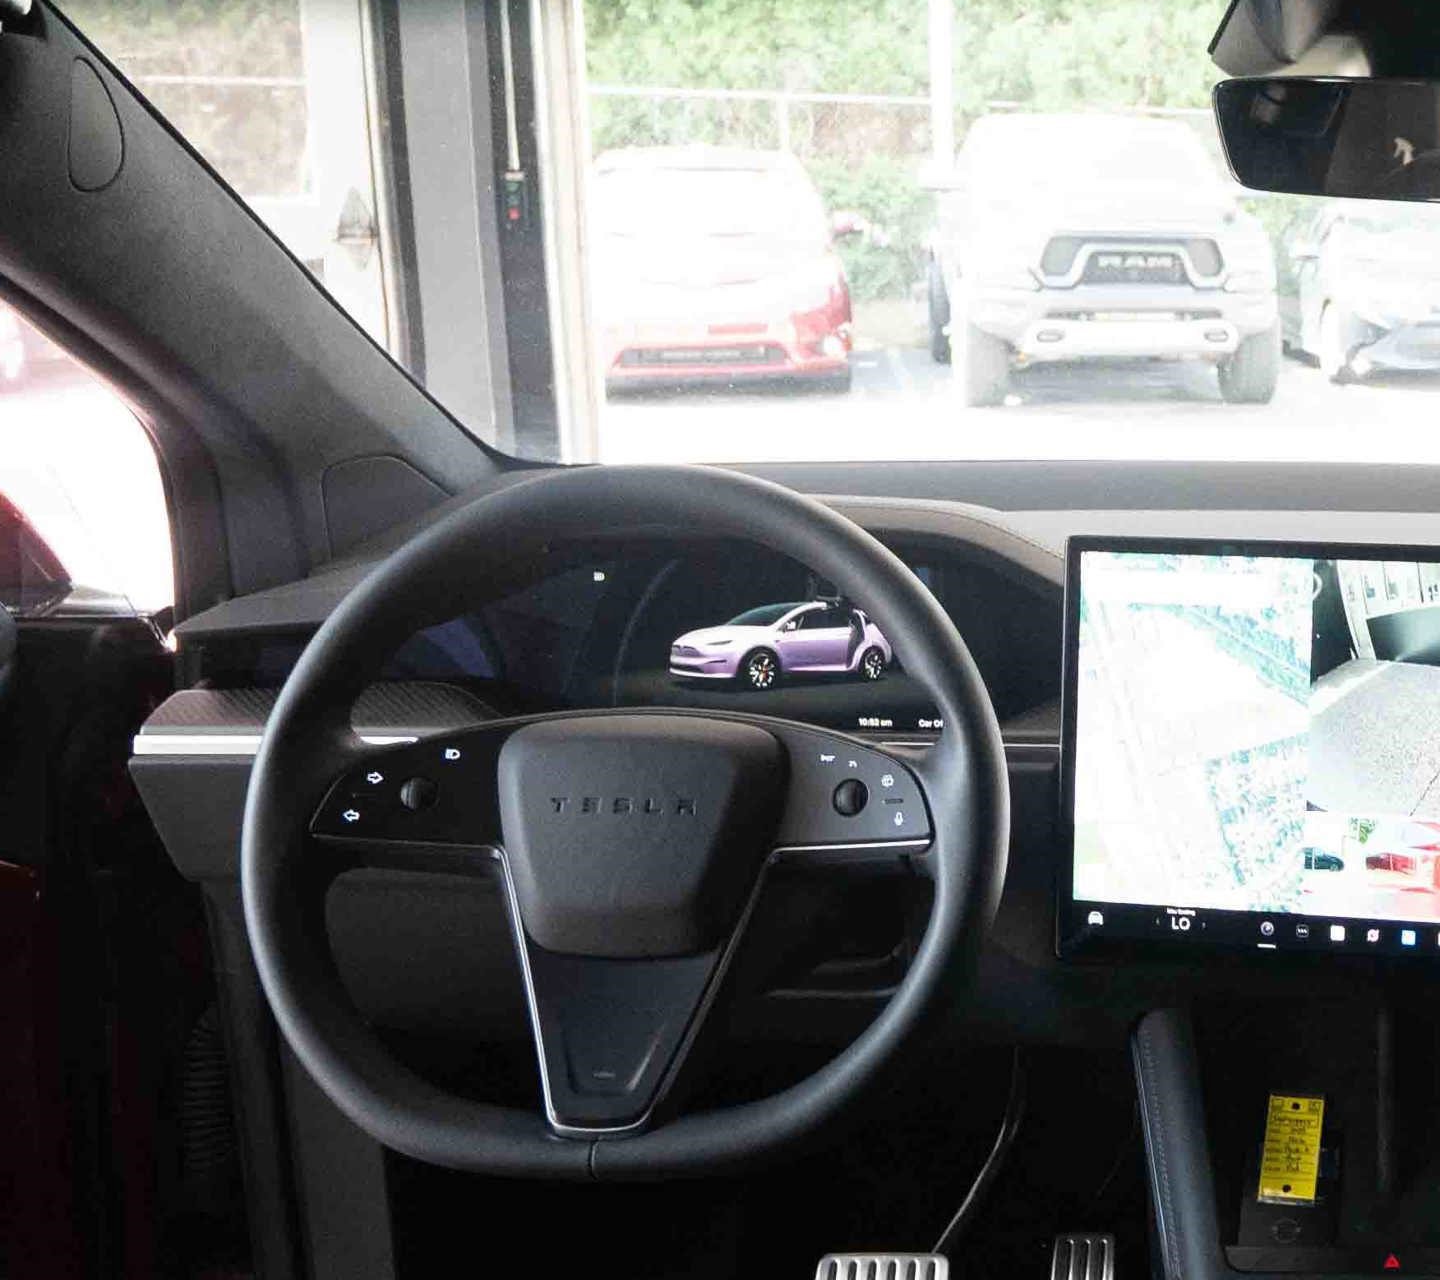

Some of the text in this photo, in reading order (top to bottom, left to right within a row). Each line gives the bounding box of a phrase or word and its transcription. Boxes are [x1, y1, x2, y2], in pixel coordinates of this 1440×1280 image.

[1097, 255, 1173, 268] RAM
[550, 795, 698, 816] TESLA
[1171, 916, 1191, 931] LO
